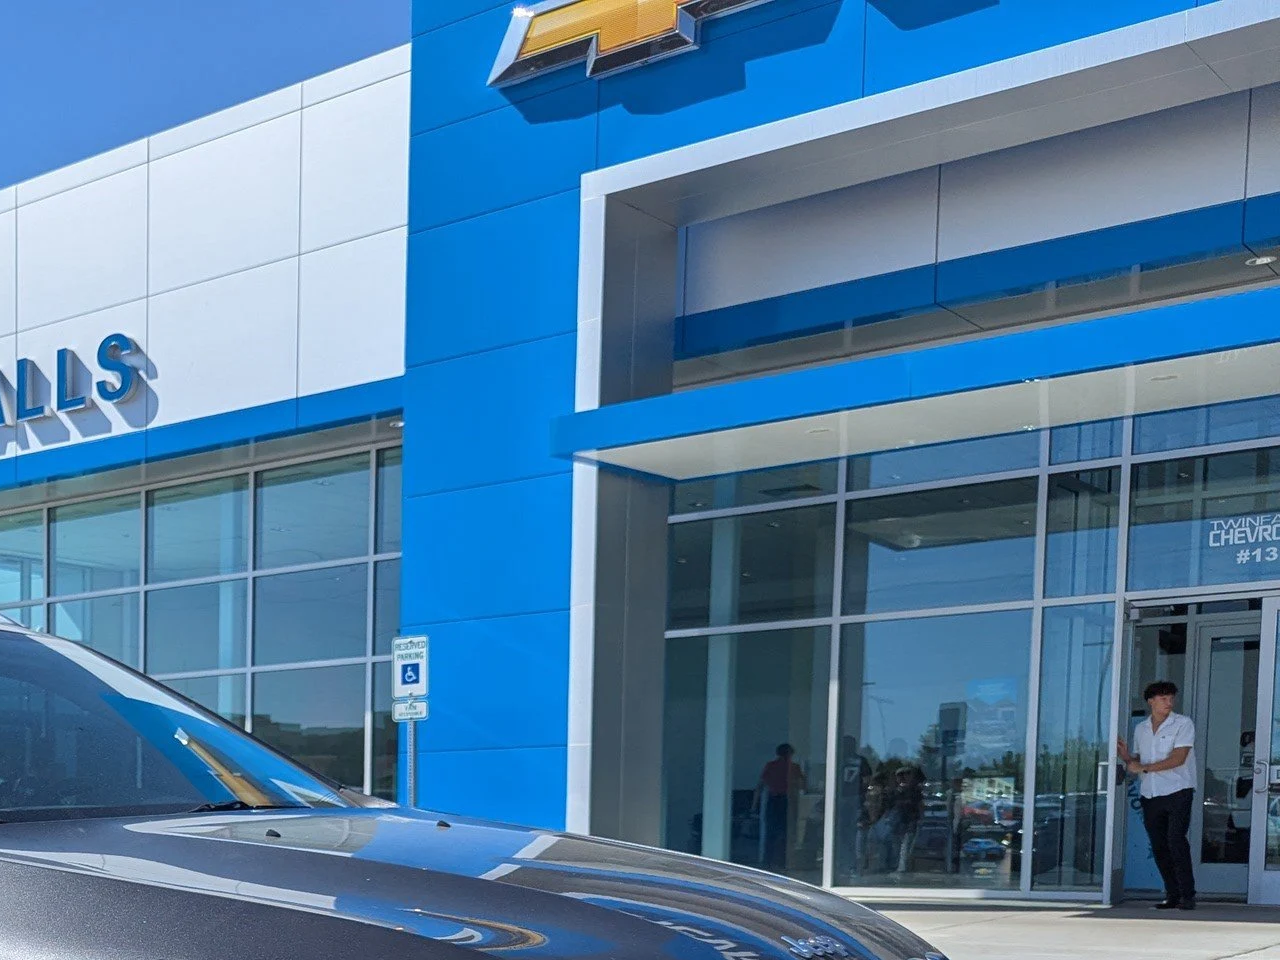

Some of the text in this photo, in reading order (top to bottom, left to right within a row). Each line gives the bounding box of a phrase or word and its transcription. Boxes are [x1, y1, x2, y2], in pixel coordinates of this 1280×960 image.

[1236, 546, 1278, 565] #13
[395, 641, 426, 651] RESERVED
[397, 652, 424, 661] PARKING
